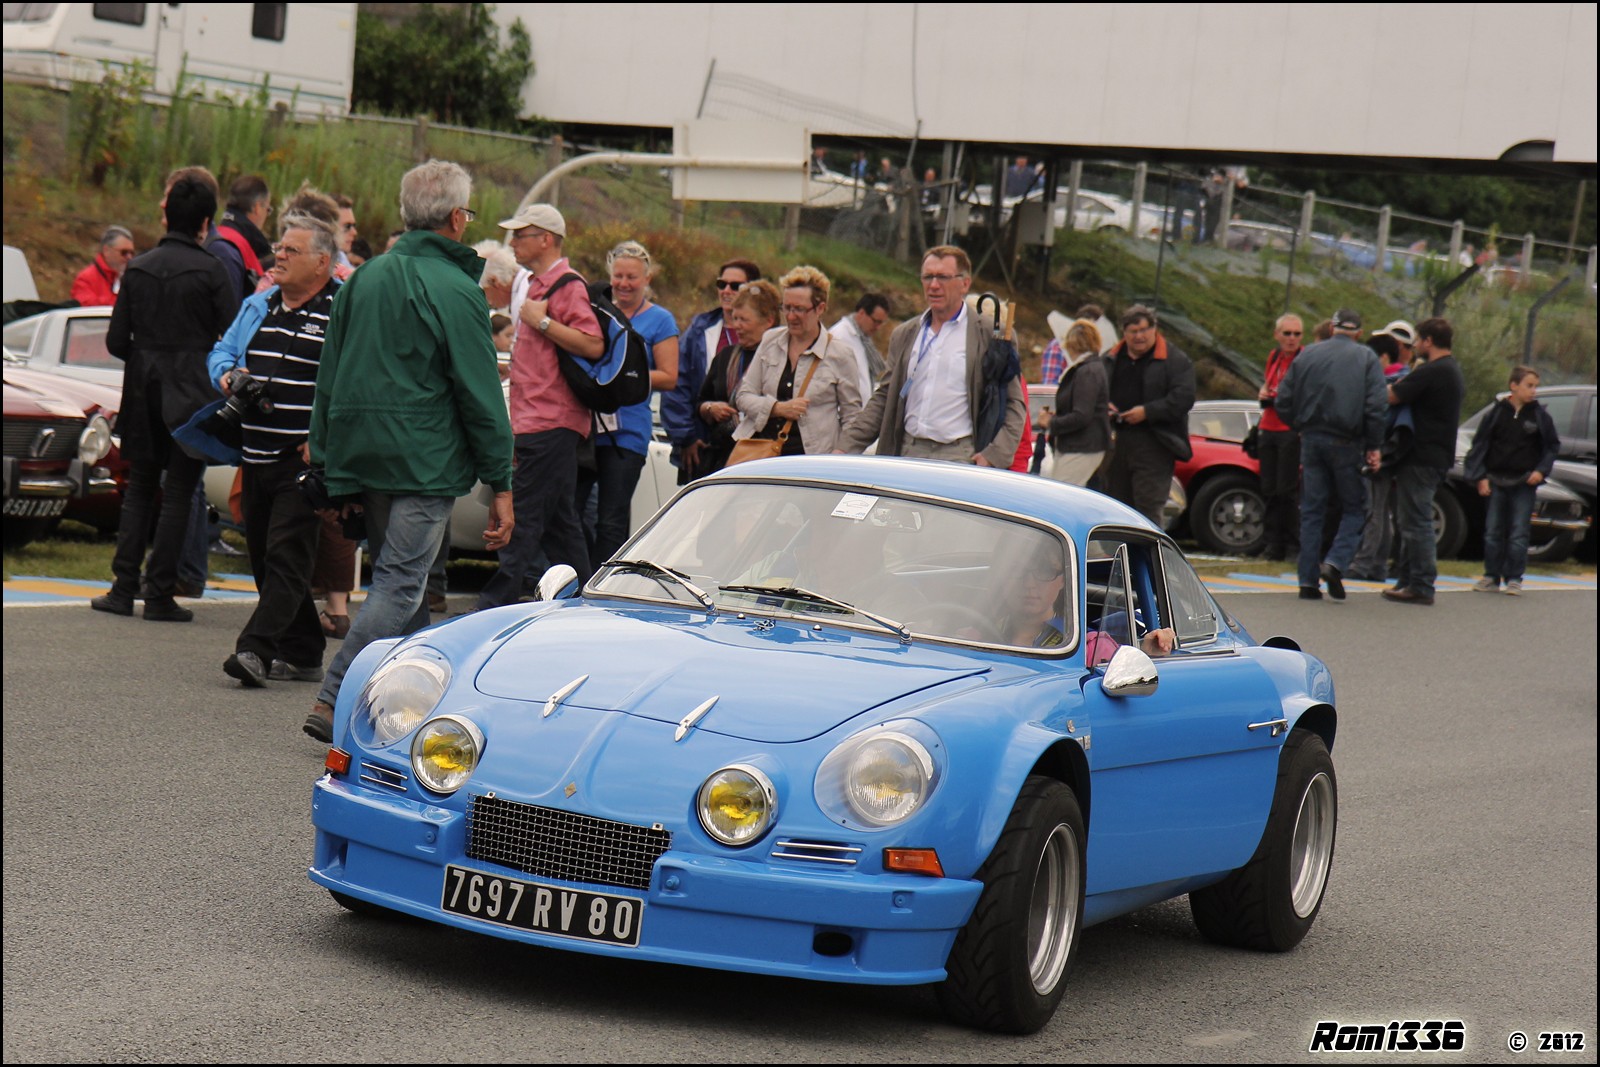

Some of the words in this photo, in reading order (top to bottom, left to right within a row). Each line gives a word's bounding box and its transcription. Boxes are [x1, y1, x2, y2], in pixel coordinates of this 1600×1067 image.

[450, 869, 525, 921] 7697
[532, 887, 578, 931] RV
[588, 897, 633, 939] 80
